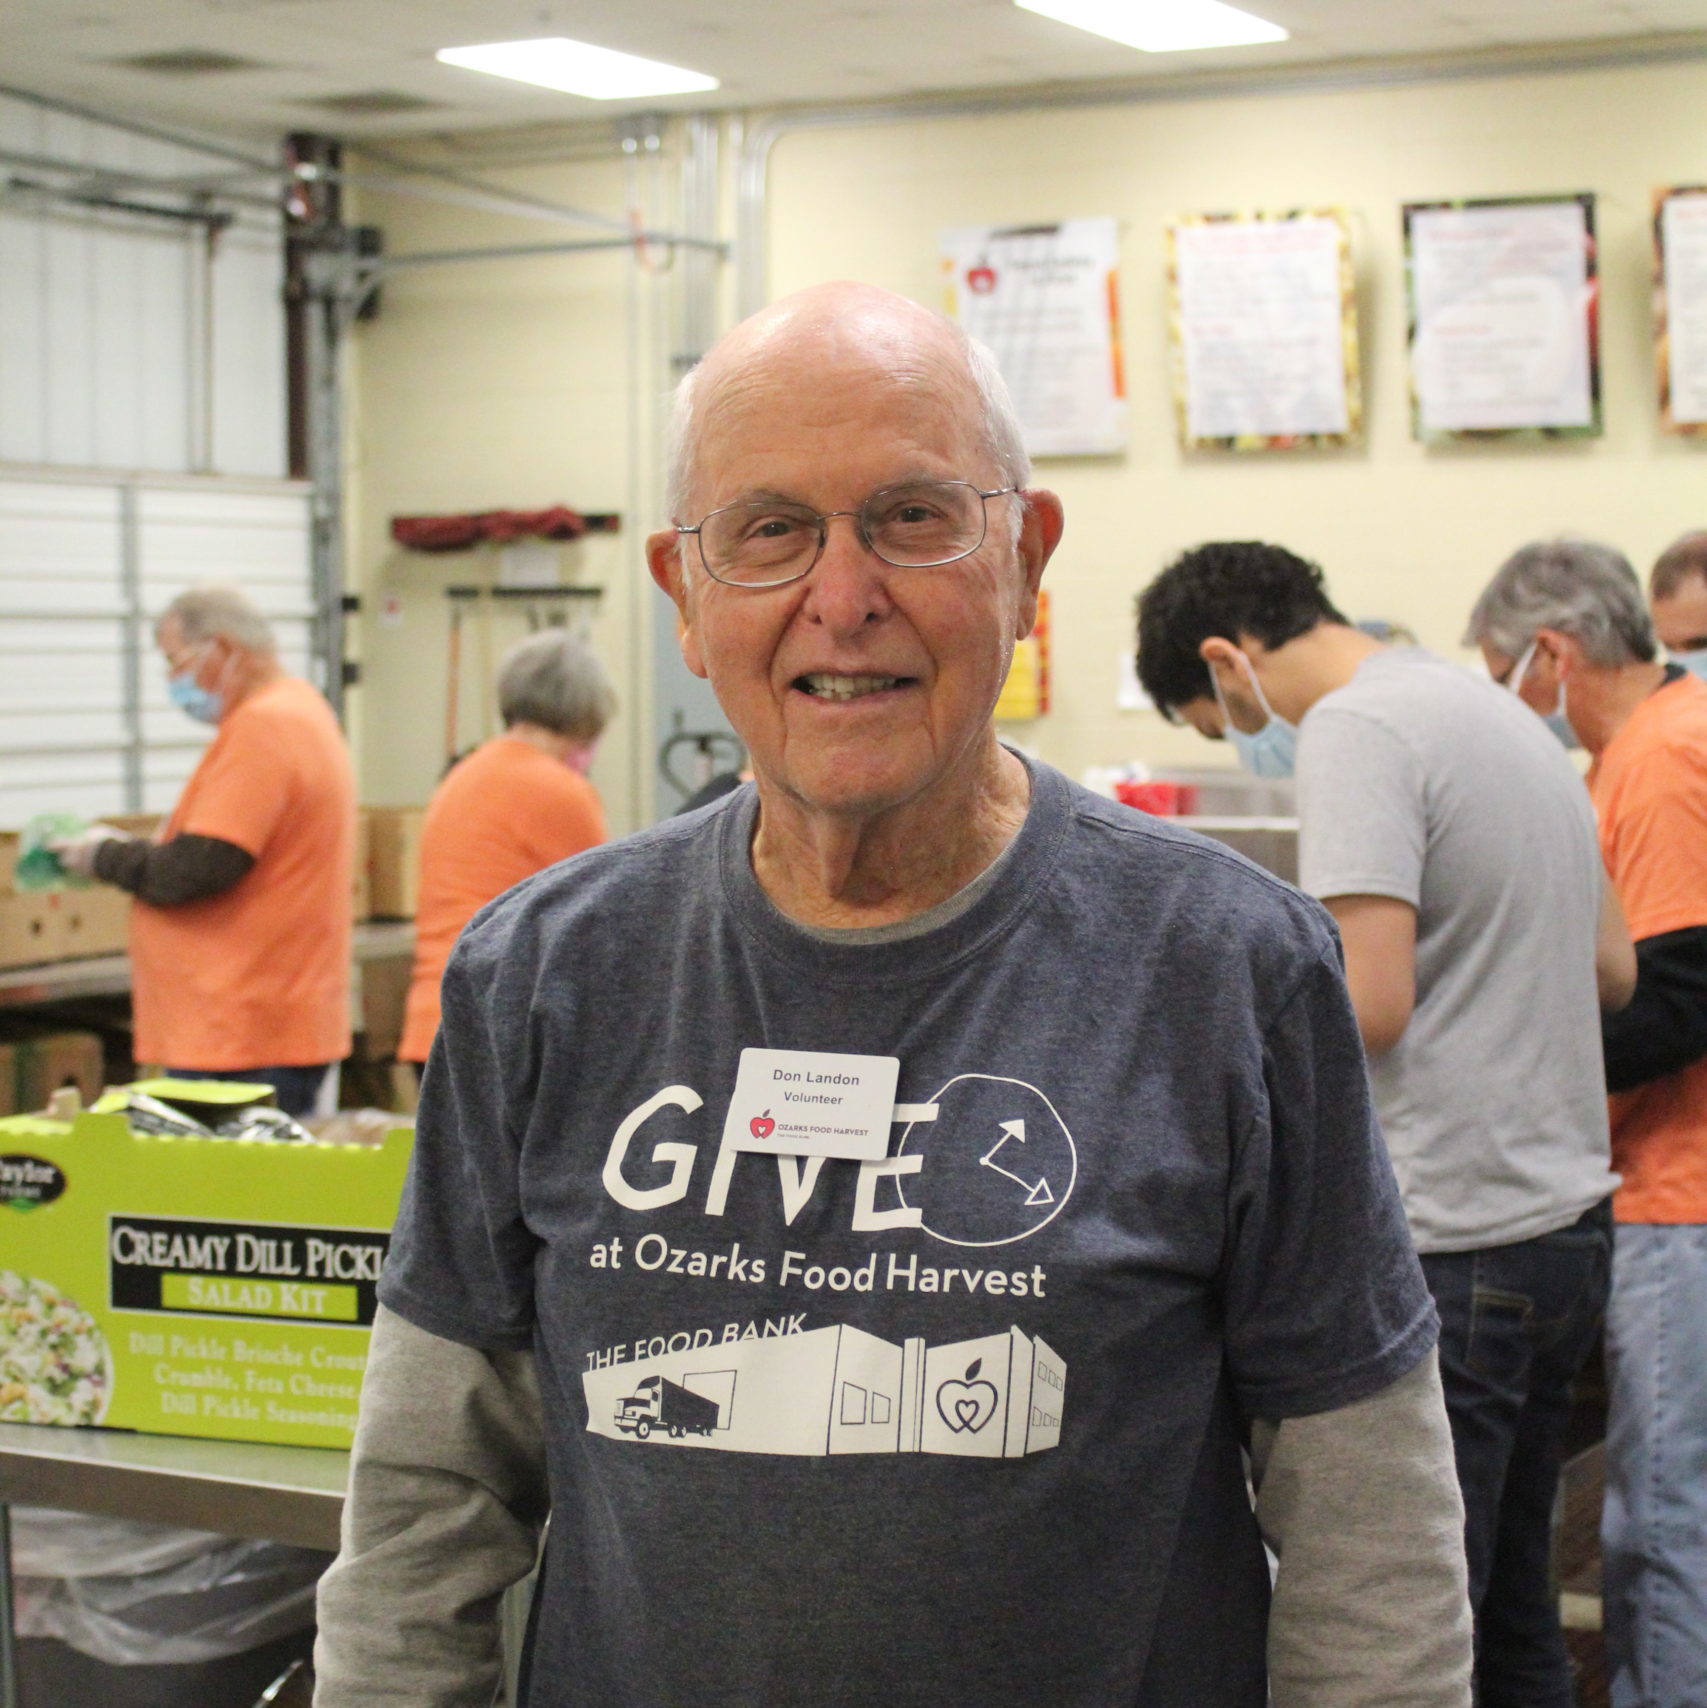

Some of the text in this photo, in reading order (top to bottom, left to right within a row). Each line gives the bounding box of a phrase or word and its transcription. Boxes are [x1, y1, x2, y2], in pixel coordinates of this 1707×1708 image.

[773, 1069, 860, 1086] Don Landon
[784, 1091, 844, 1105] Volunteer
[778, 1123, 869, 1137] OZARKS FOOD HARVEST
[111, 1225, 384, 1281] CREAMY DILL PICKL
[590, 1233, 1047, 1298] at Ozarks Food Harvest
[188, 1276, 329, 1315] SALAD KIT
[129, 1331, 165, 1355] Dill
[170, 1335, 227, 1360] Pickle
[586, 1312, 808, 1372] THE FOOD BANK
[245, 1369, 284, 1394] Feta
[160, 1391, 197, 1415] Dill
[202, 1394, 261, 1421] Pickle
